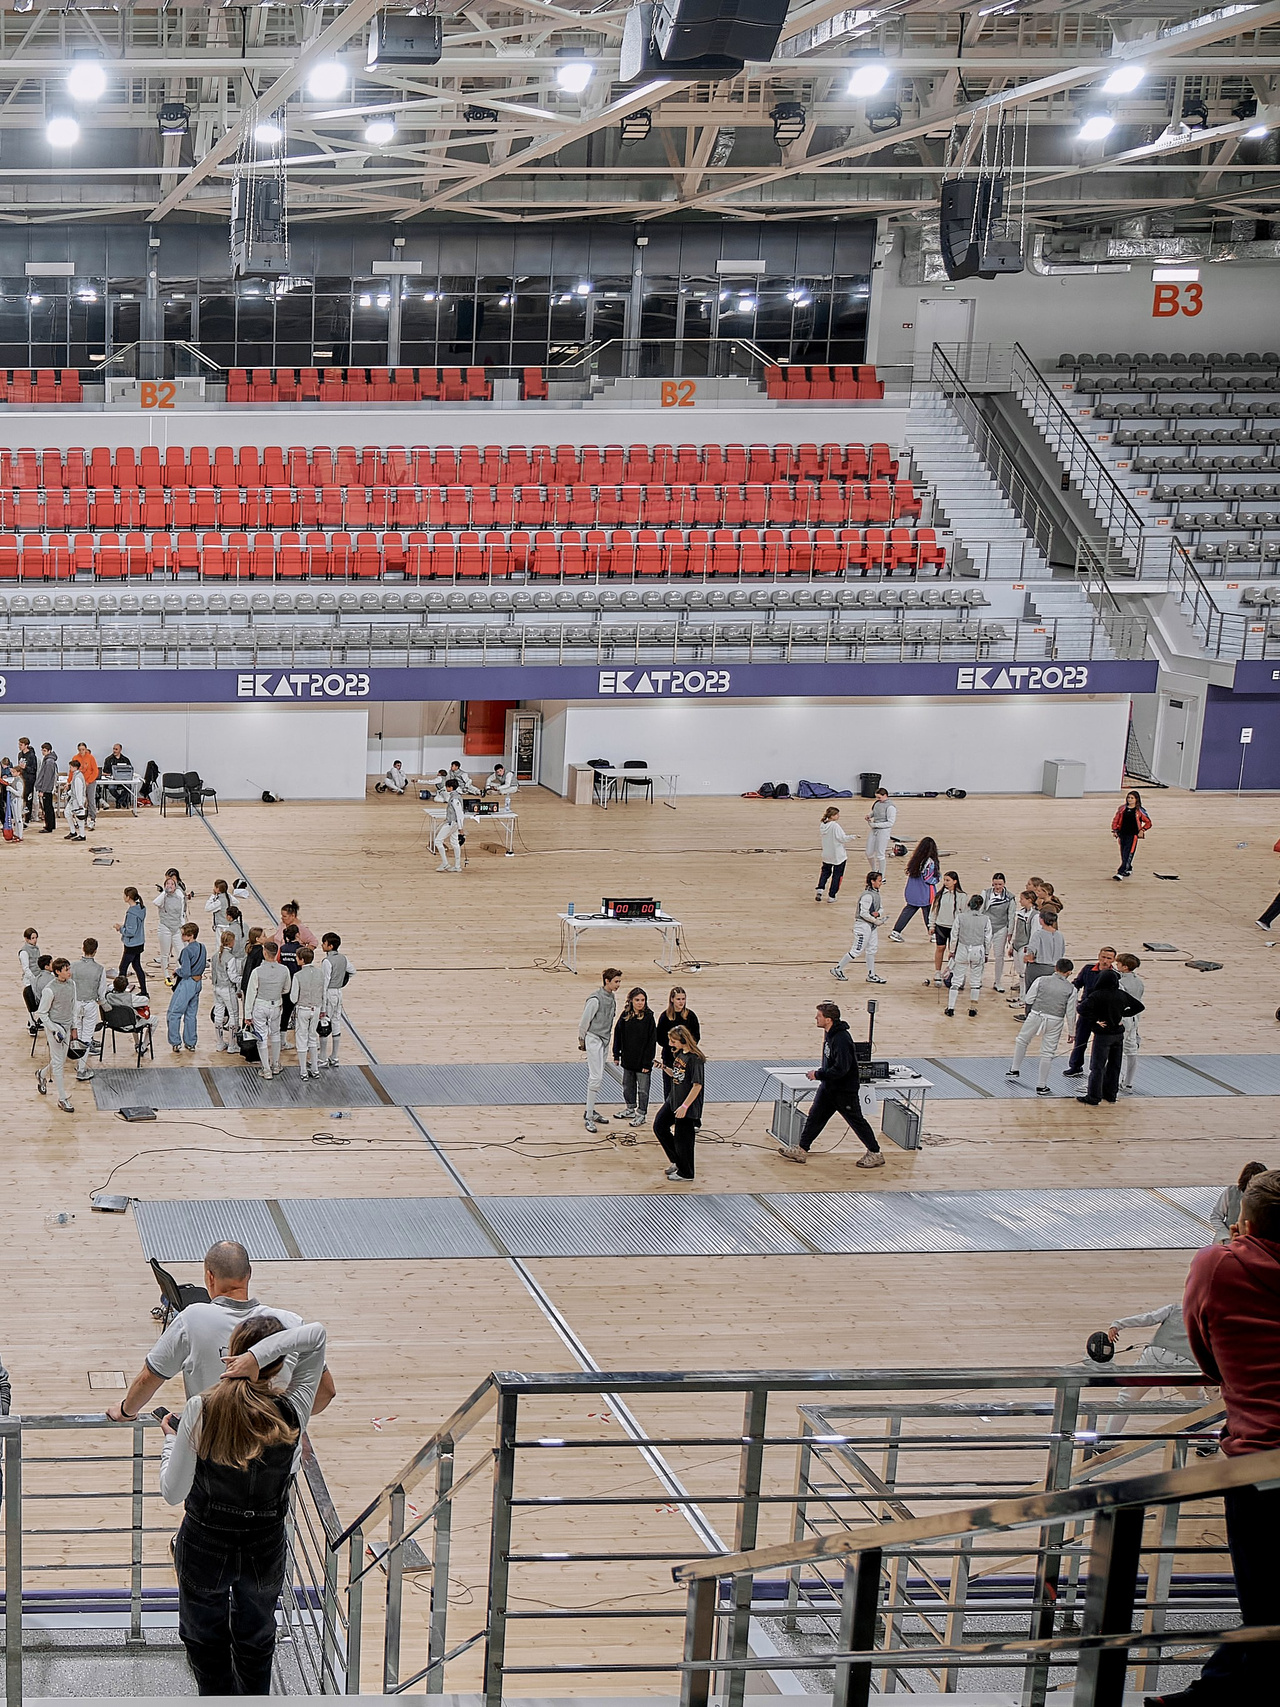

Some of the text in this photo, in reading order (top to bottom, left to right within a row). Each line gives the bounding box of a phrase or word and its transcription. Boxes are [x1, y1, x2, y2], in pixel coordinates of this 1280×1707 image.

[1152, 283, 1203, 317] B3
[141, 381, 176, 408] B2
[661, 380, 696, 407] B2
[237, 673, 370, 697] EKAT2023
[598, 670, 731, 694] EKAT2023
[956, 666, 1088, 690] EKAT2023
[864, 1094, 871, 1104] 6
